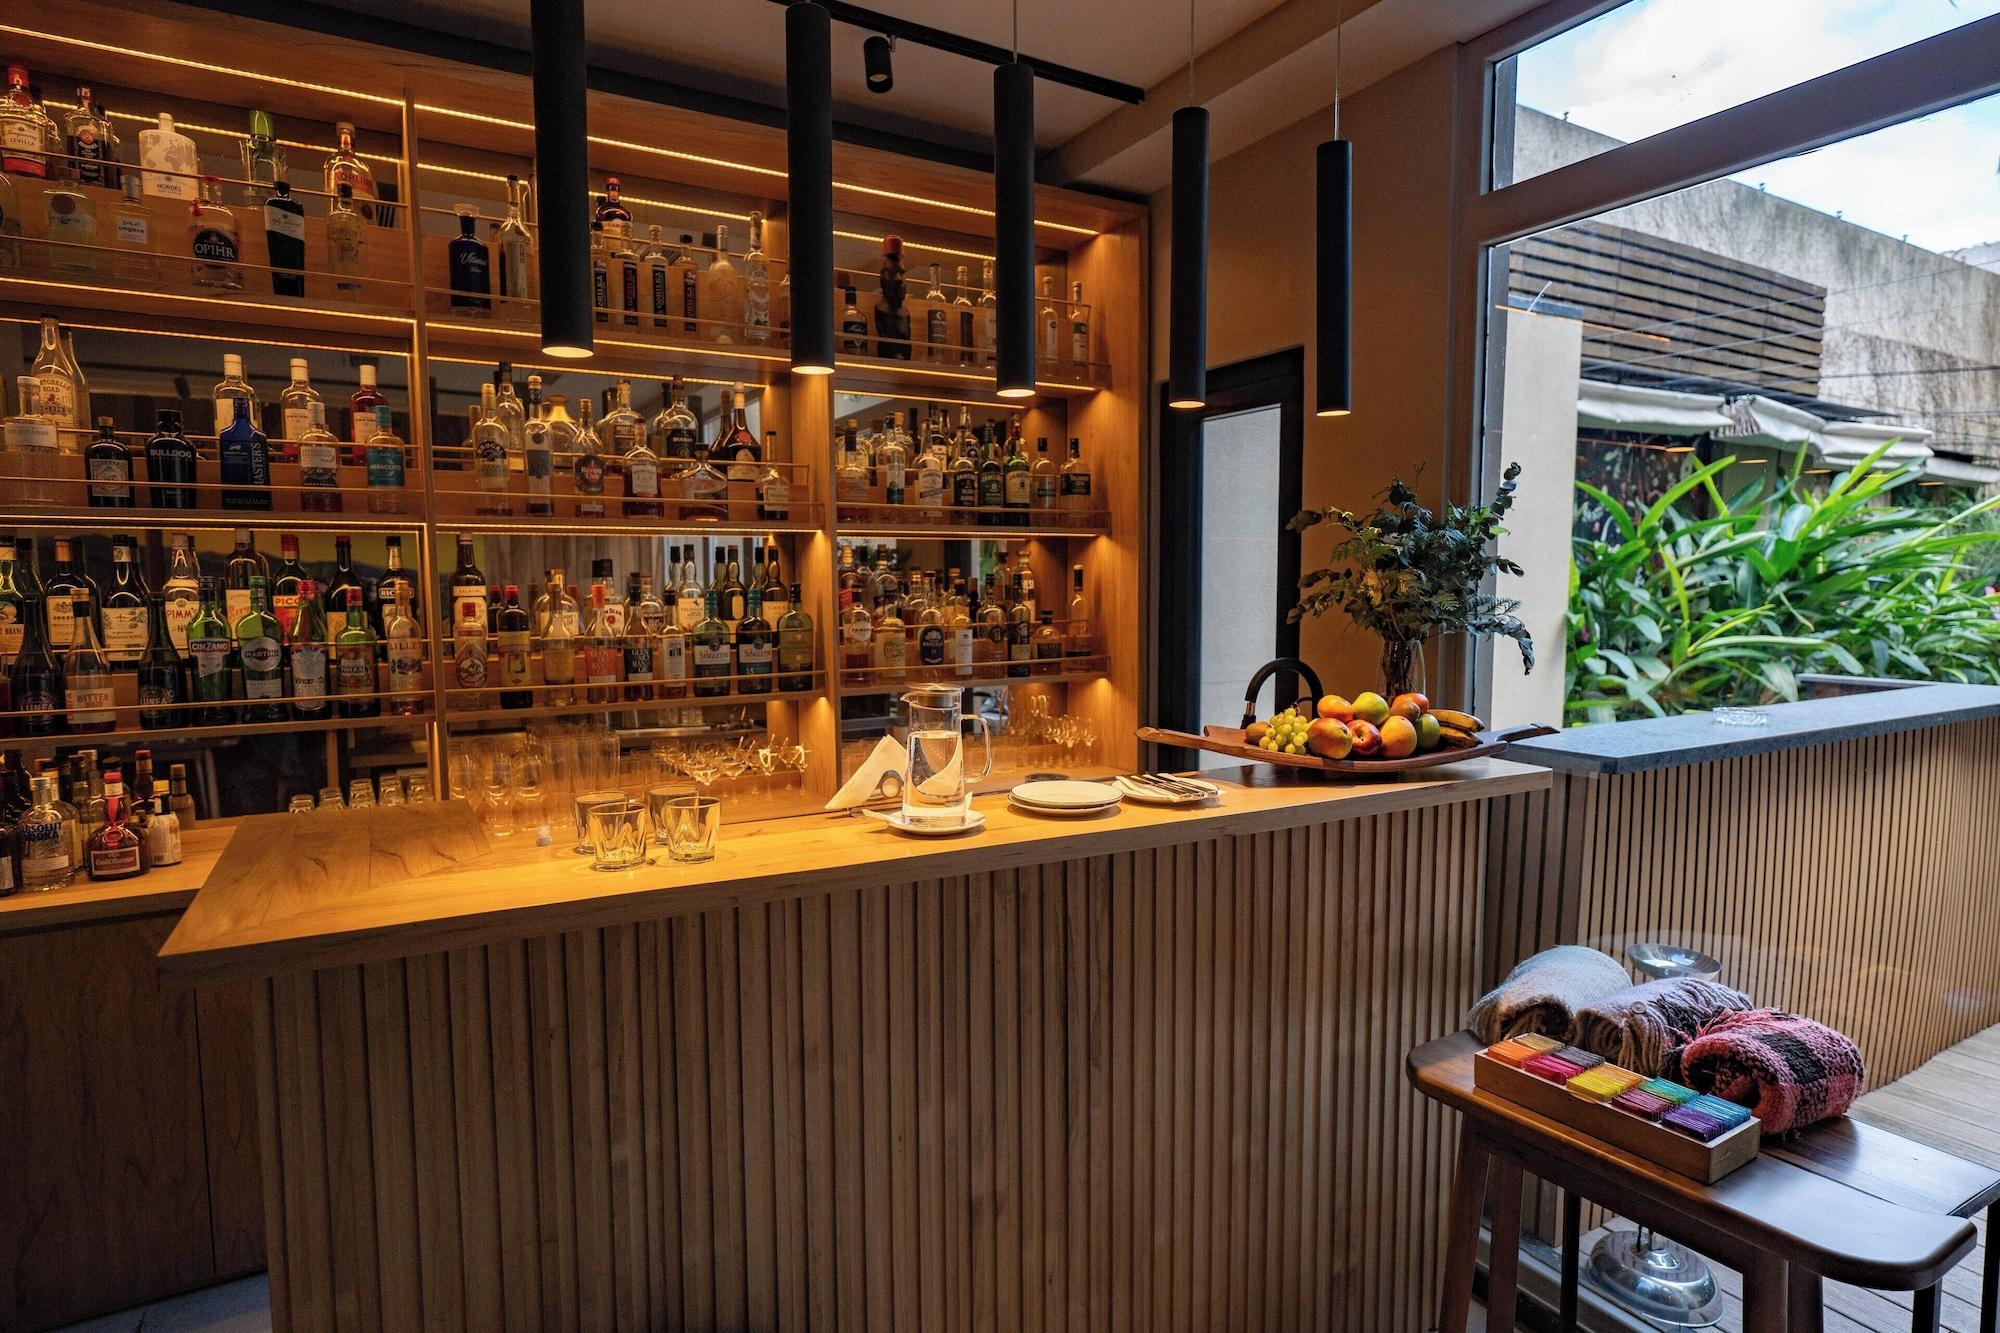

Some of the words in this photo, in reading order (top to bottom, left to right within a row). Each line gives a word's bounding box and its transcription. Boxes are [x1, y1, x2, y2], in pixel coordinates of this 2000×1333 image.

[194, 242, 235, 258] OPIHR
[150, 448, 192, 459] BULLDOG
[275, 597, 301, 605] PICO
[167, 607, 198, 619] PIMM'S
[5, 627, 22, 635] BRANC
[191, 643, 228, 652] CINZANO
[245, 649, 279, 658] MARTINI
[77, 693, 109, 703] BITTER
